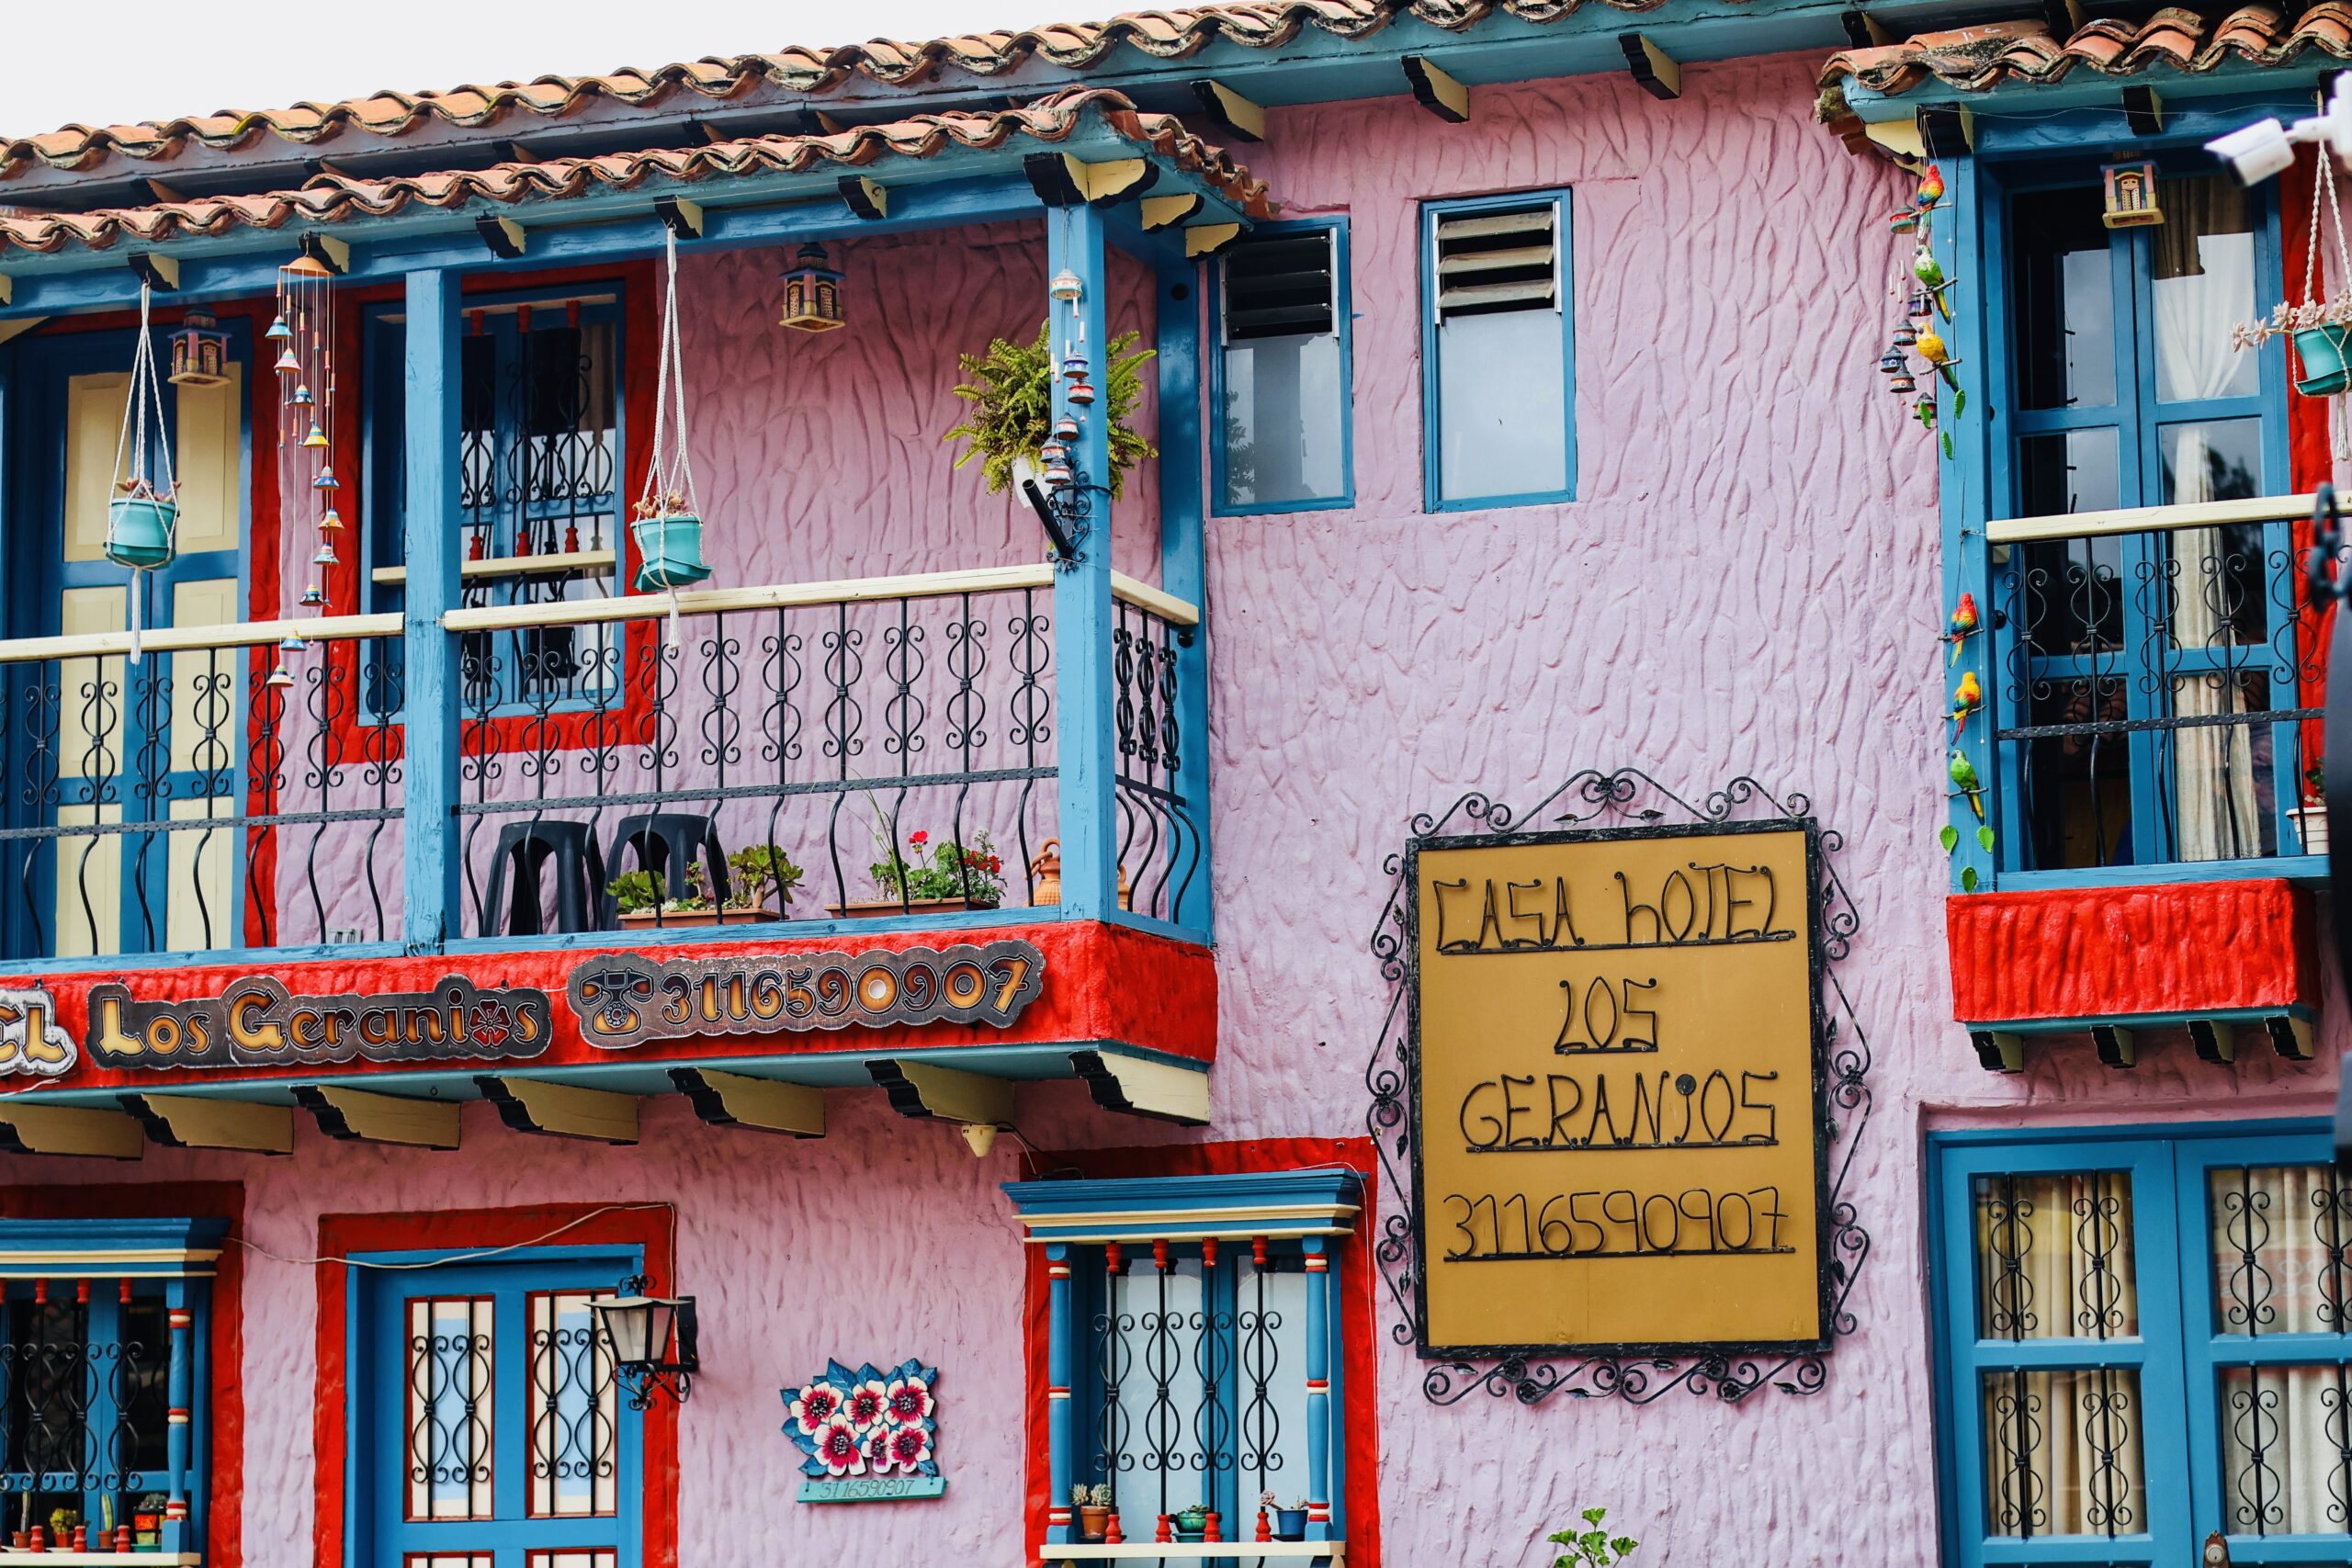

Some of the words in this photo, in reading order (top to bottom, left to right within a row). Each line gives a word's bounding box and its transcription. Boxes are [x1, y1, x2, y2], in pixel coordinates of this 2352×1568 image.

[1432, 875, 1585, 953] CASA
[661, 953, 1031, 1025] 3116590907
[1555, 976, 1658, 1053] LOS
[97, 996, 210, 1056] Los
[1443, 1186, 1790, 1258] 3116590907
[820, 1479, 915, 1499] 3116590907
